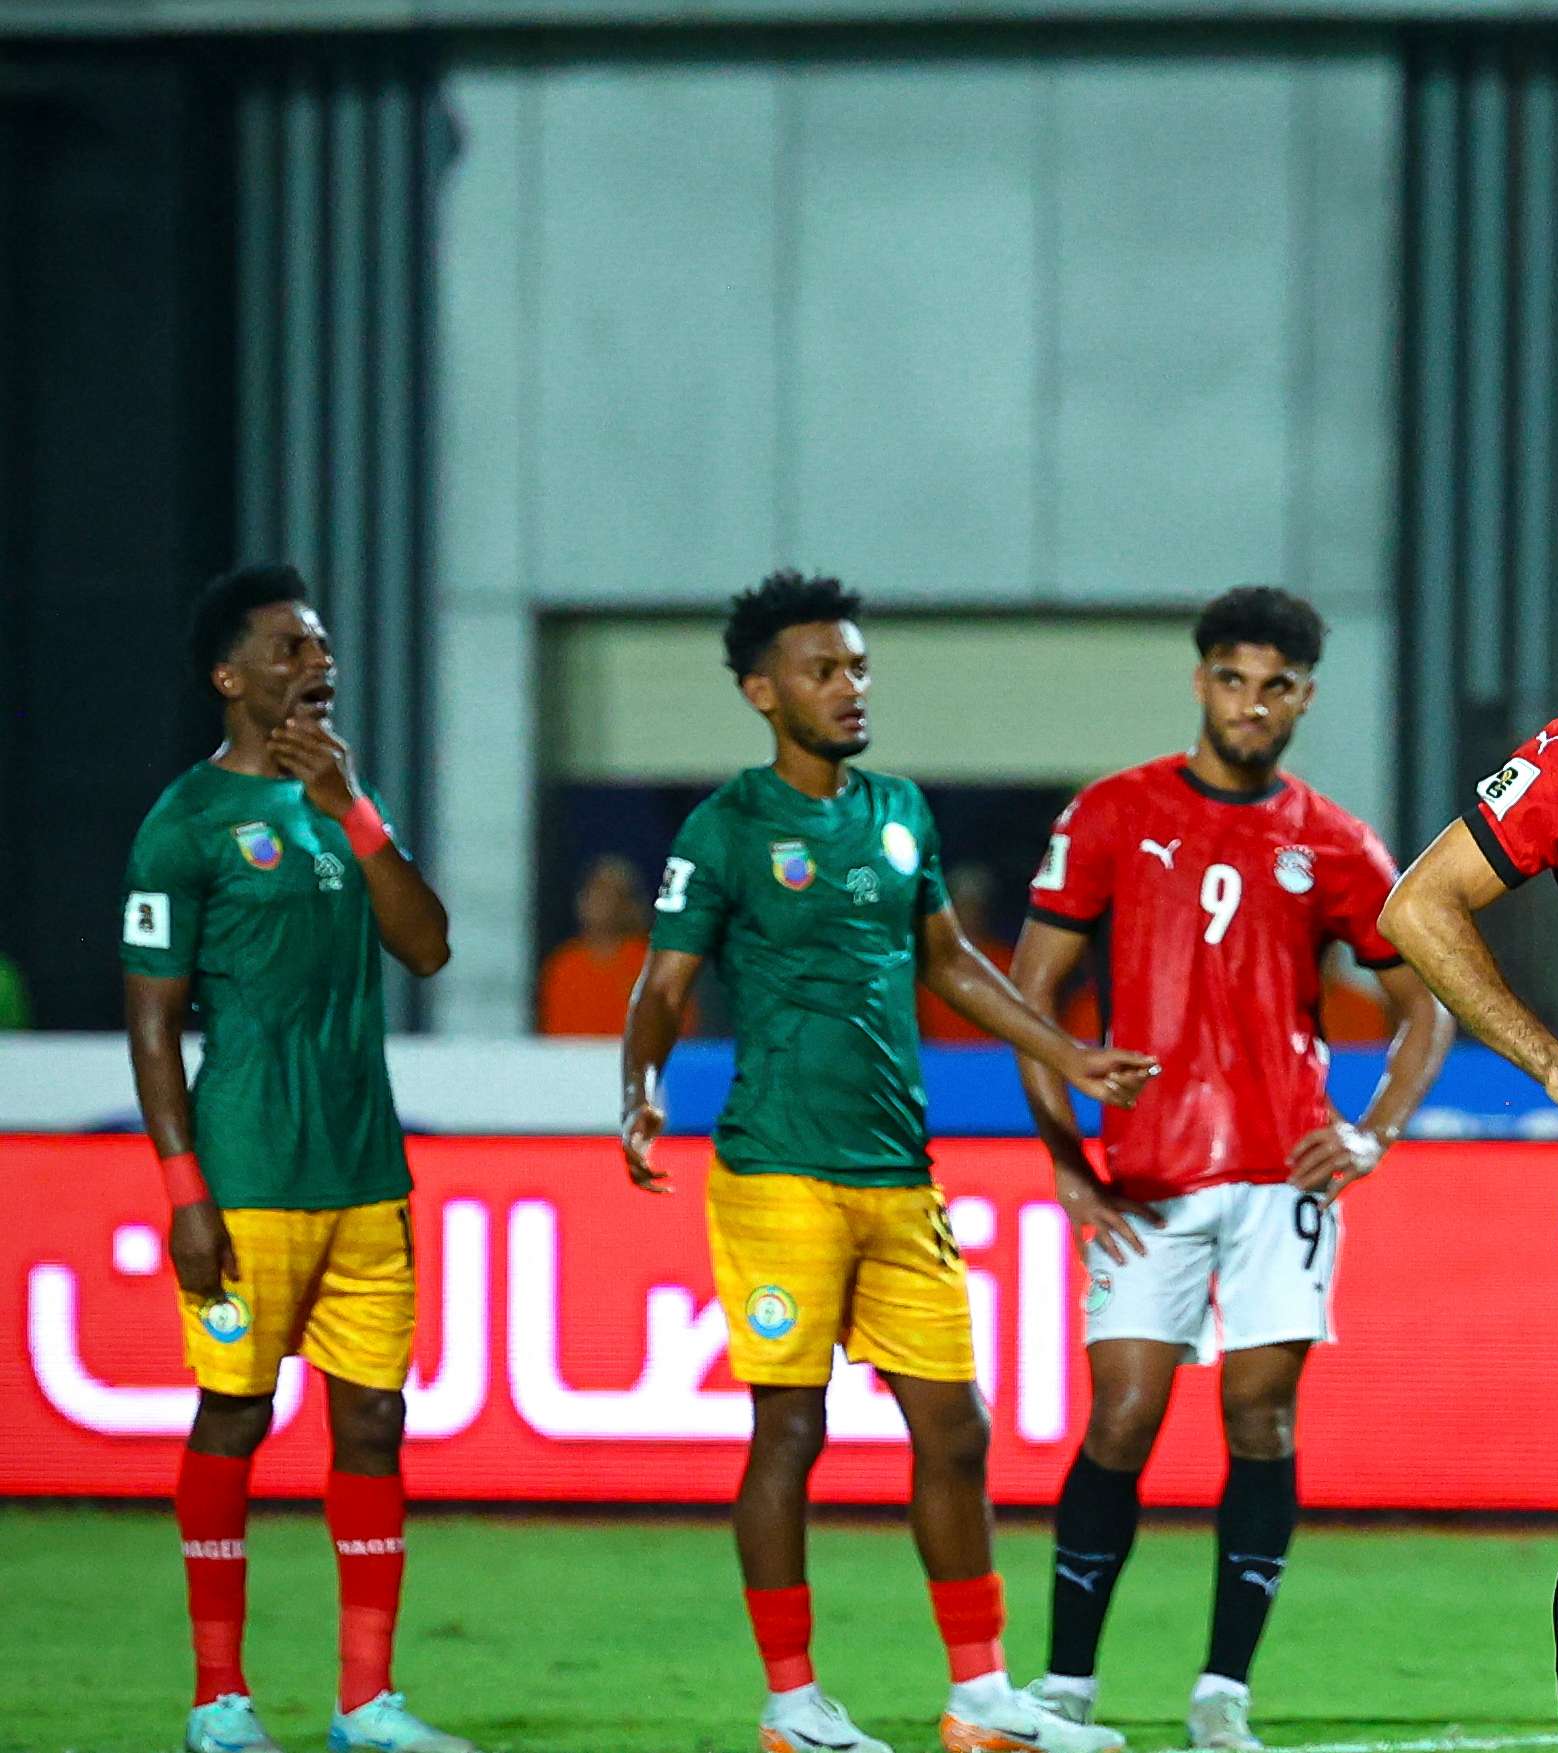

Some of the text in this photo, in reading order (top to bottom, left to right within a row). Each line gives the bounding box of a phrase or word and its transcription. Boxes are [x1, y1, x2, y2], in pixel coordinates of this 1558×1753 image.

[1199, 863, 1243, 945] 9
[1295, 1194, 1321, 1270] 9
[28, 1197, 1070, 1441] اتصالت
